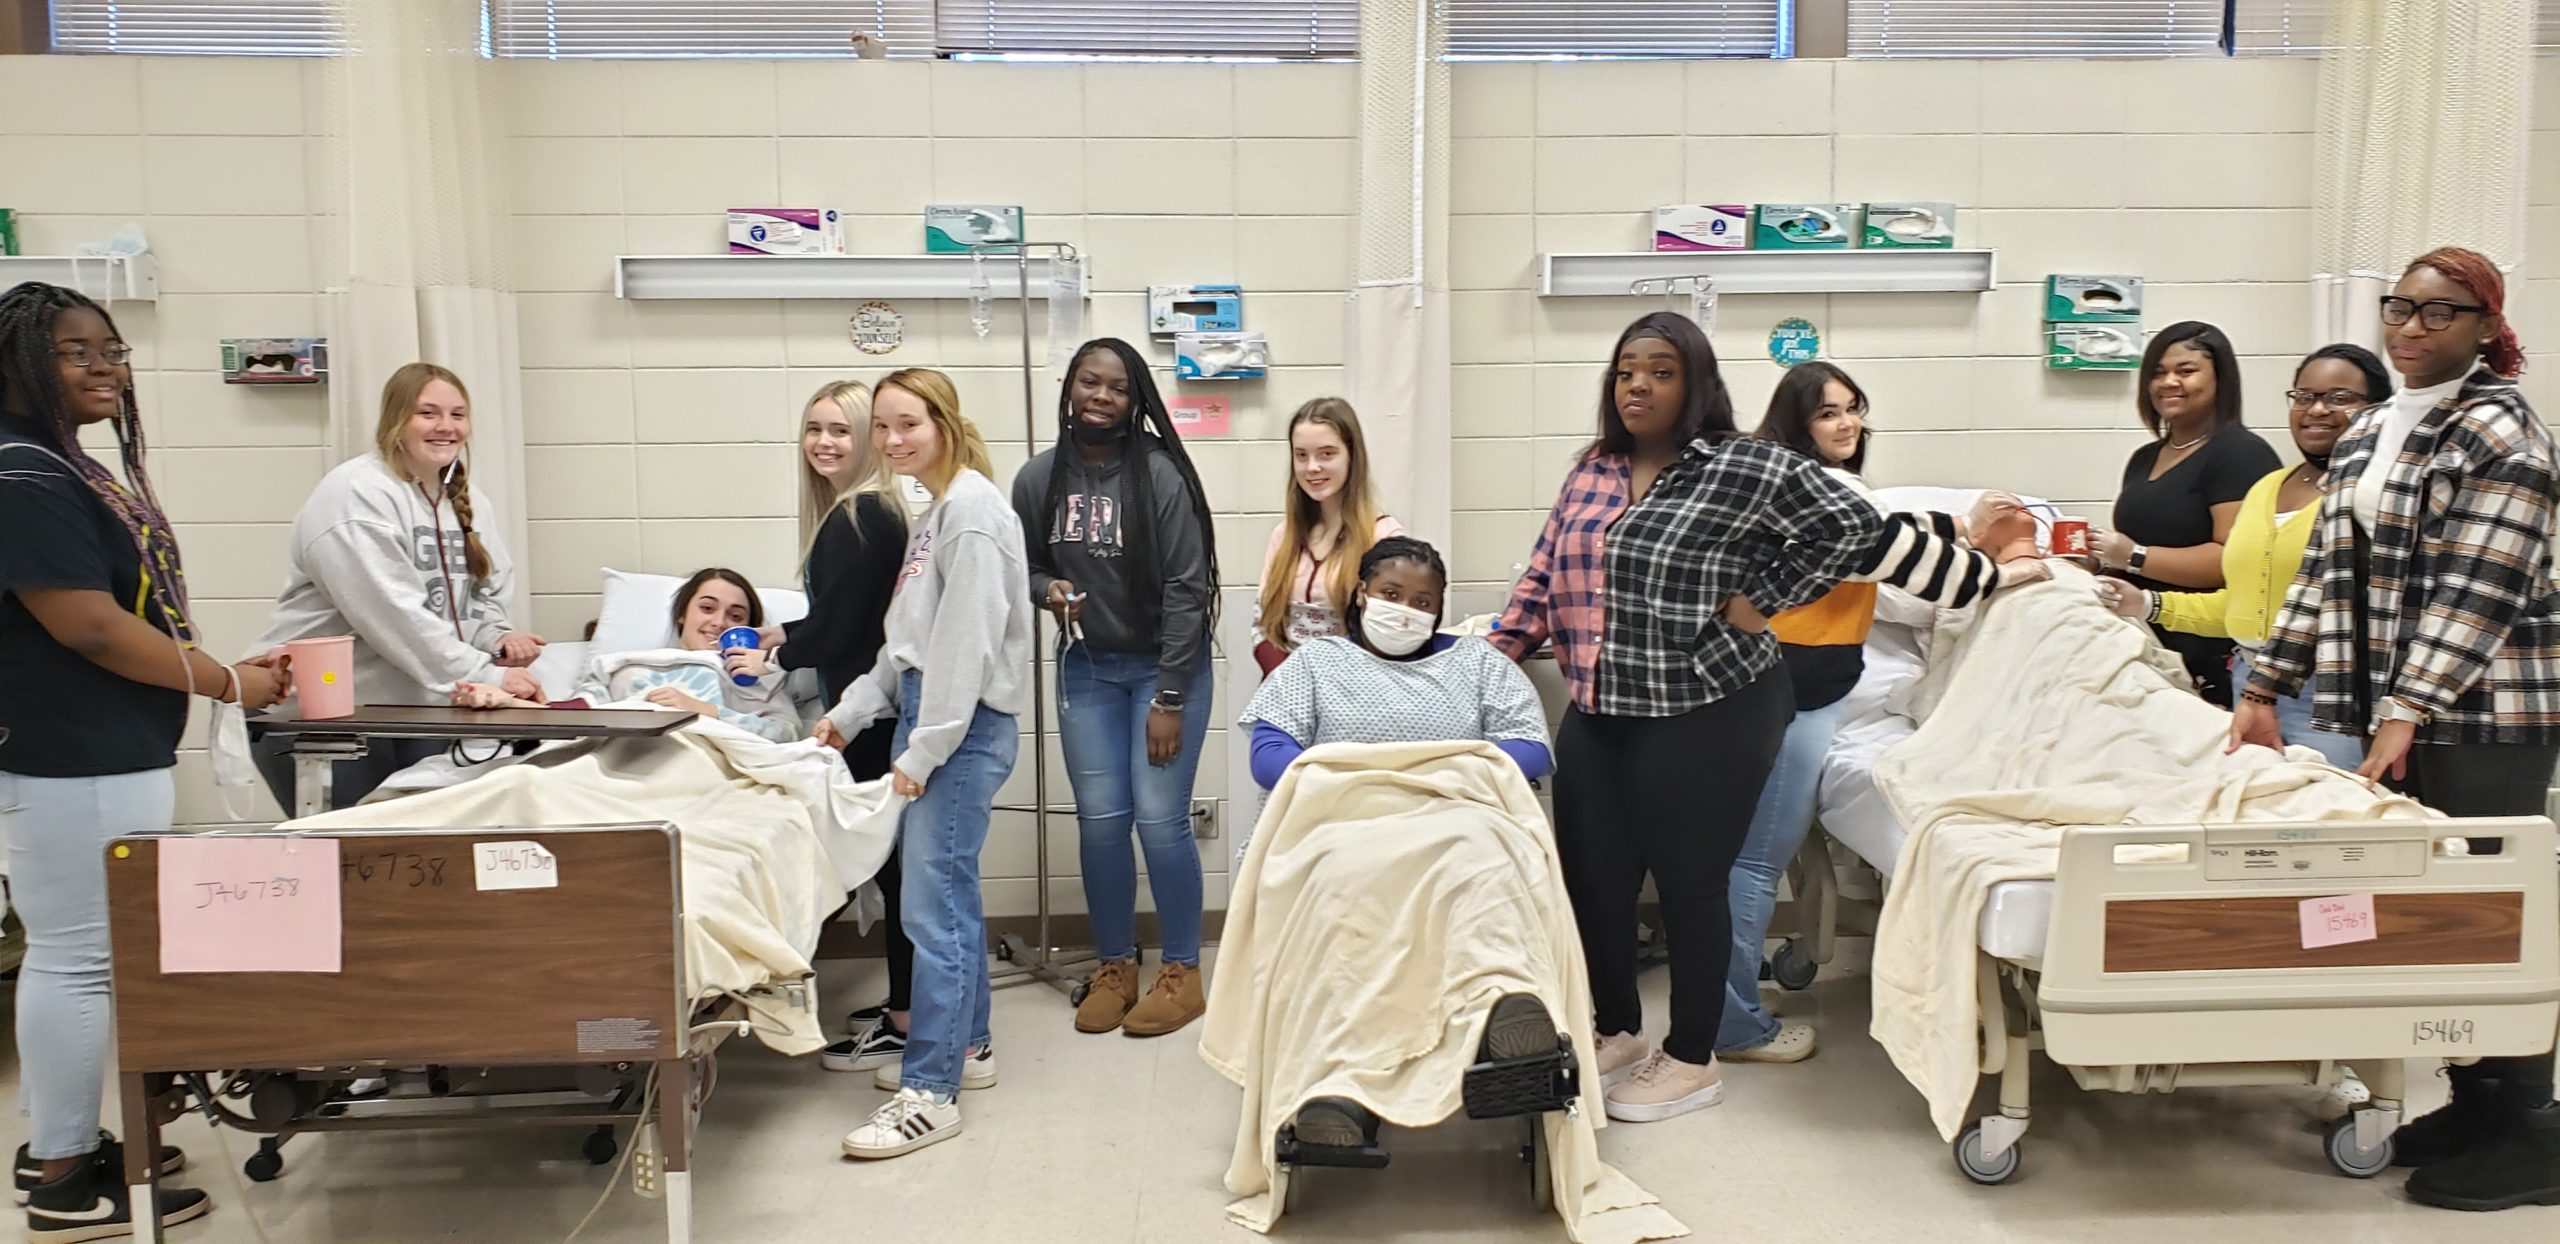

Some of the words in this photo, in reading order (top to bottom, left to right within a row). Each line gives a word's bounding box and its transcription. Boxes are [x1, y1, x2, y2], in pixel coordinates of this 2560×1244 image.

[1172, 410, 1199, 421] Group
[194, 877, 301, 910] J46738
[2326, 910, 2369, 932] 15469
[2411, 1018, 2475, 1046] 15469
